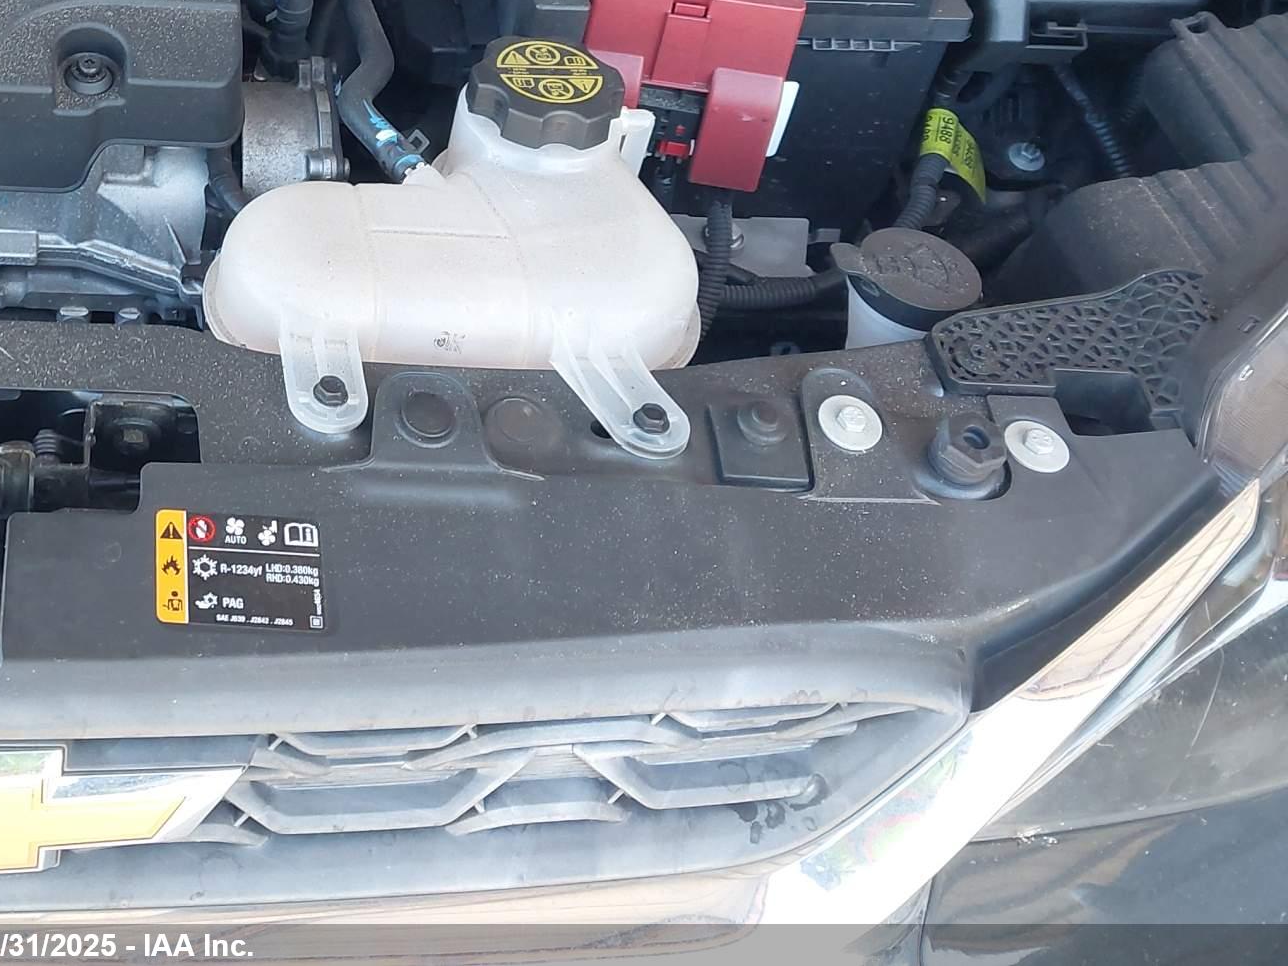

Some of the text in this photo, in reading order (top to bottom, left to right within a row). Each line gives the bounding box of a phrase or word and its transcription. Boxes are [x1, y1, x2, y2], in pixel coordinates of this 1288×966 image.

[225, 535, 247, 545] AUTO
[220, 563, 263, 577] R-1234yf
[222, 597, 244, 609] PAG
